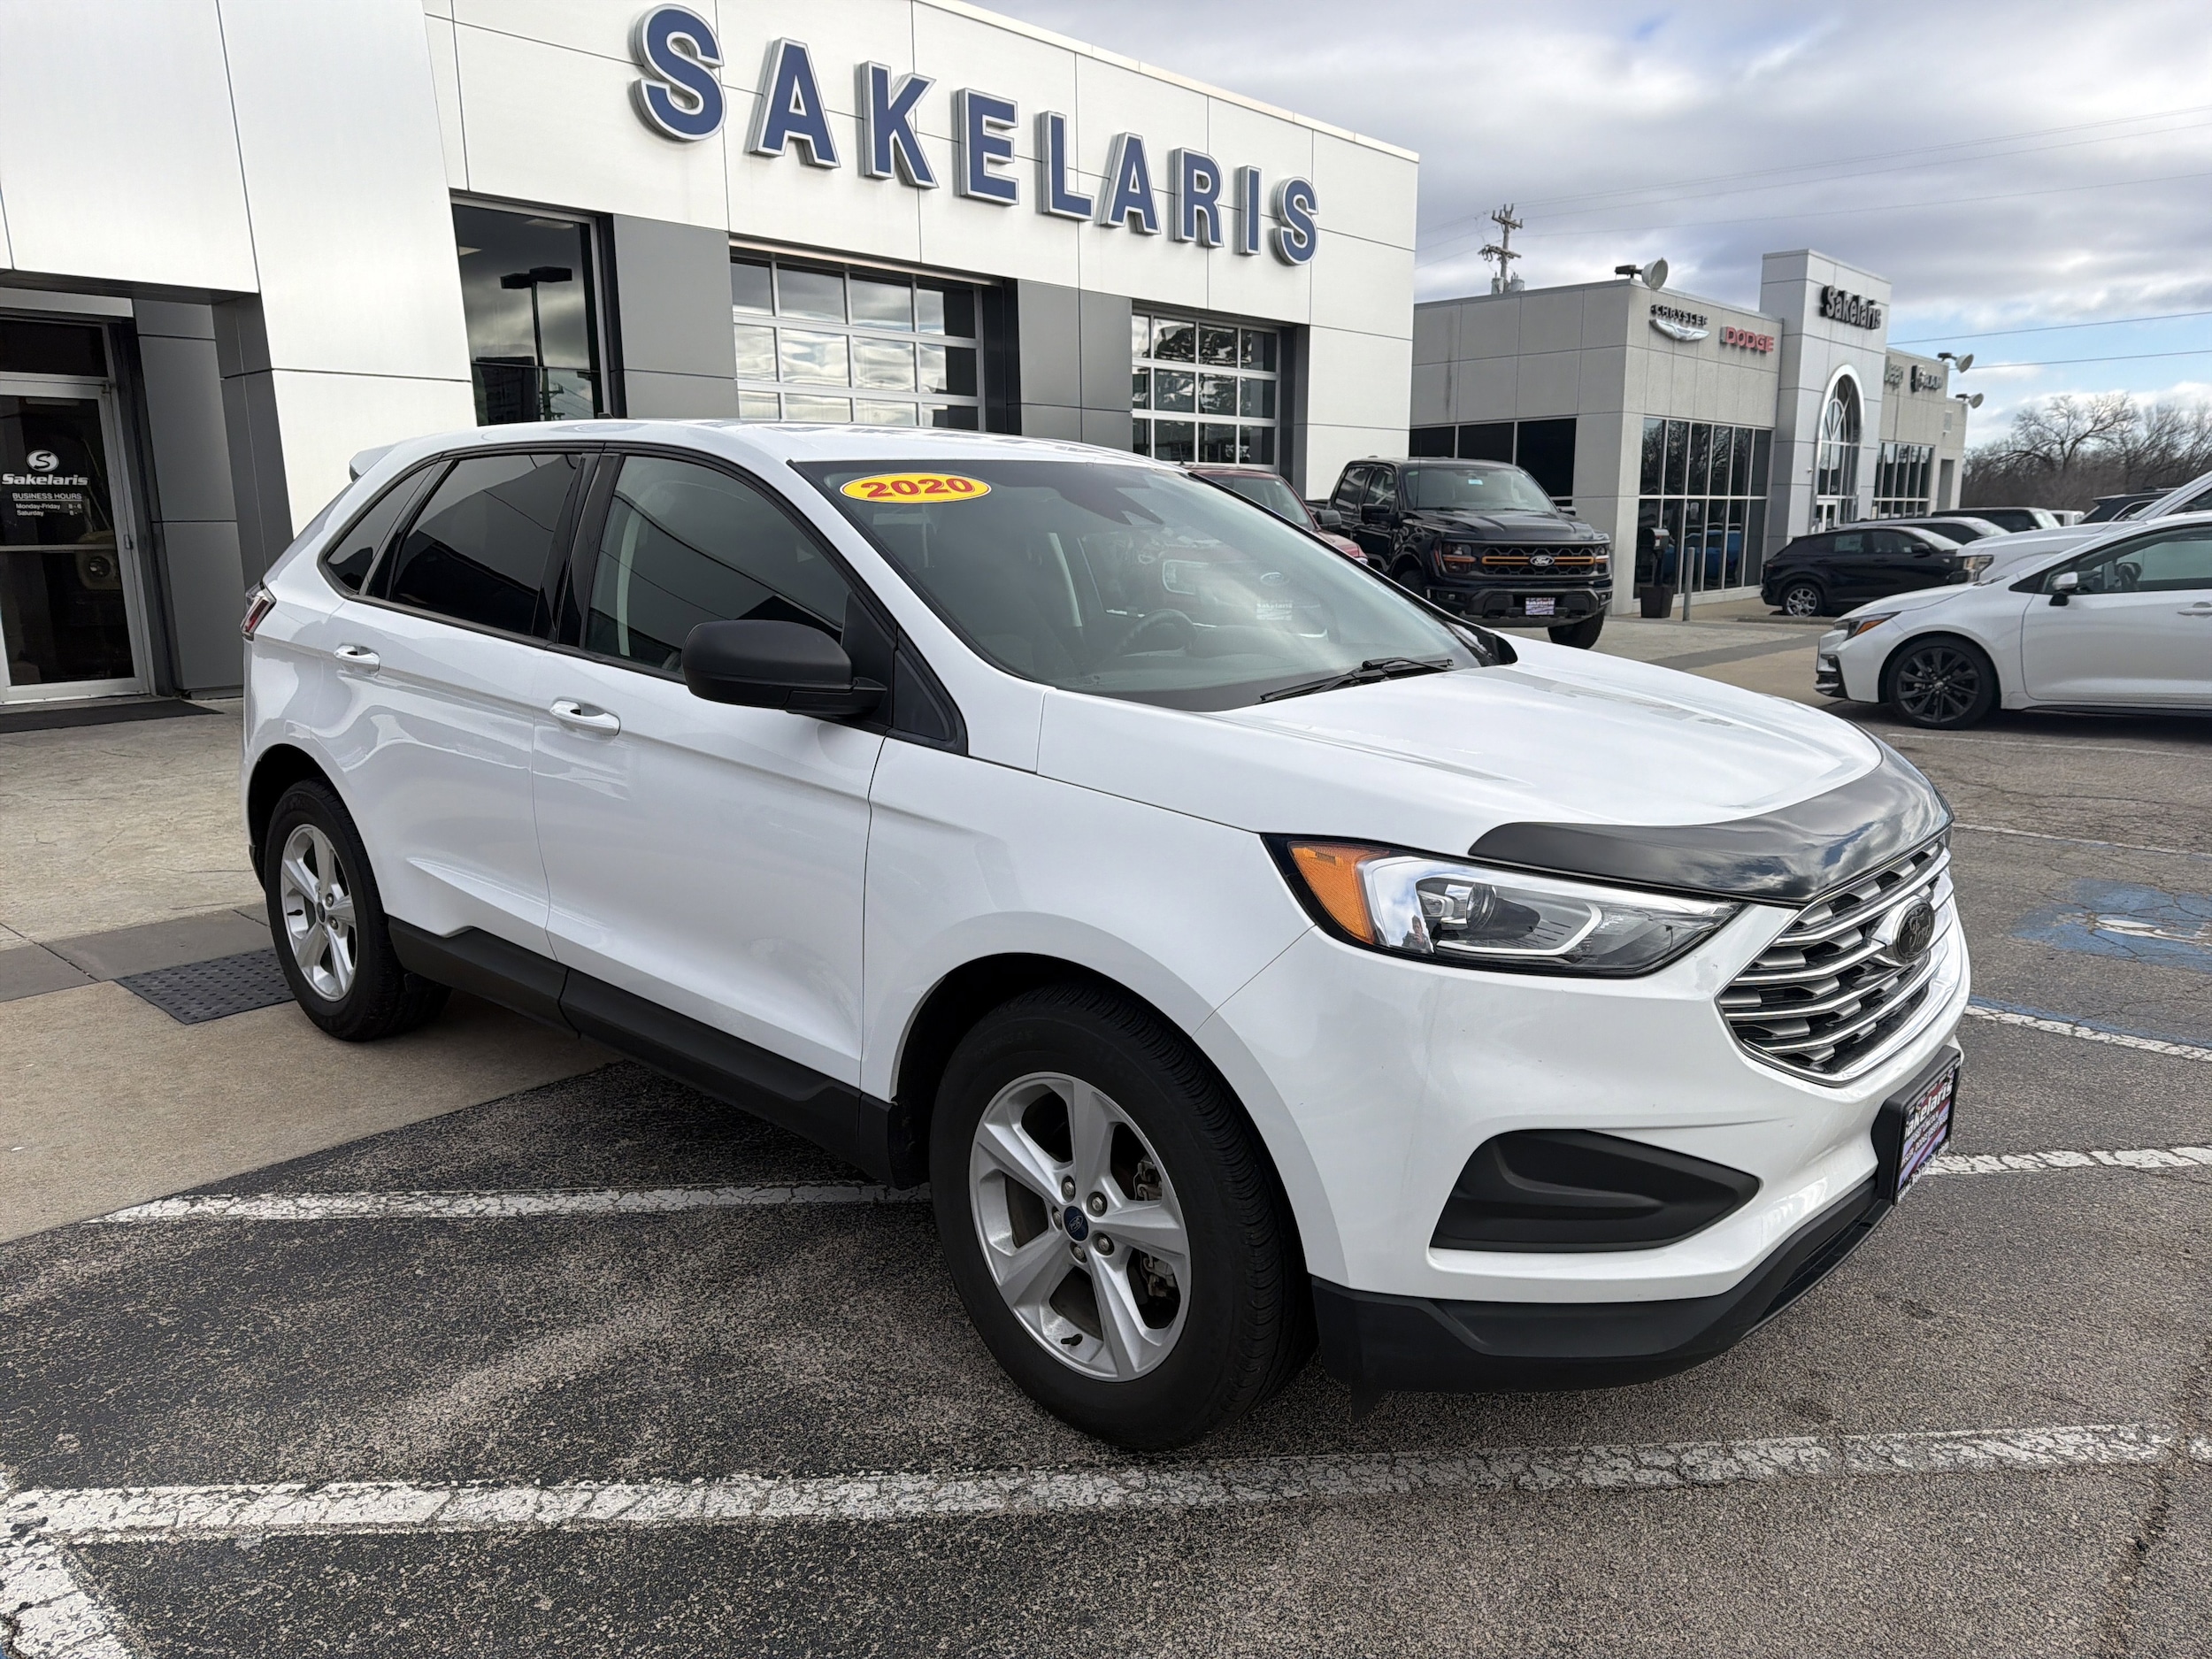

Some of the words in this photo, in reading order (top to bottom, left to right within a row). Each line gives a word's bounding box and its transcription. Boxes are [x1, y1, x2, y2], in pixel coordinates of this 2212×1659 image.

[632, 3, 1319, 265] SAKELARIS
[1650, 303, 1708, 326] CHRYSLER
[1821, 285, 1881, 330] Sakelaris
[1722, 326, 1774, 352] DODGE
[2, 473, 88, 486] Sakelaris
[860, 478, 976, 499] 2020
